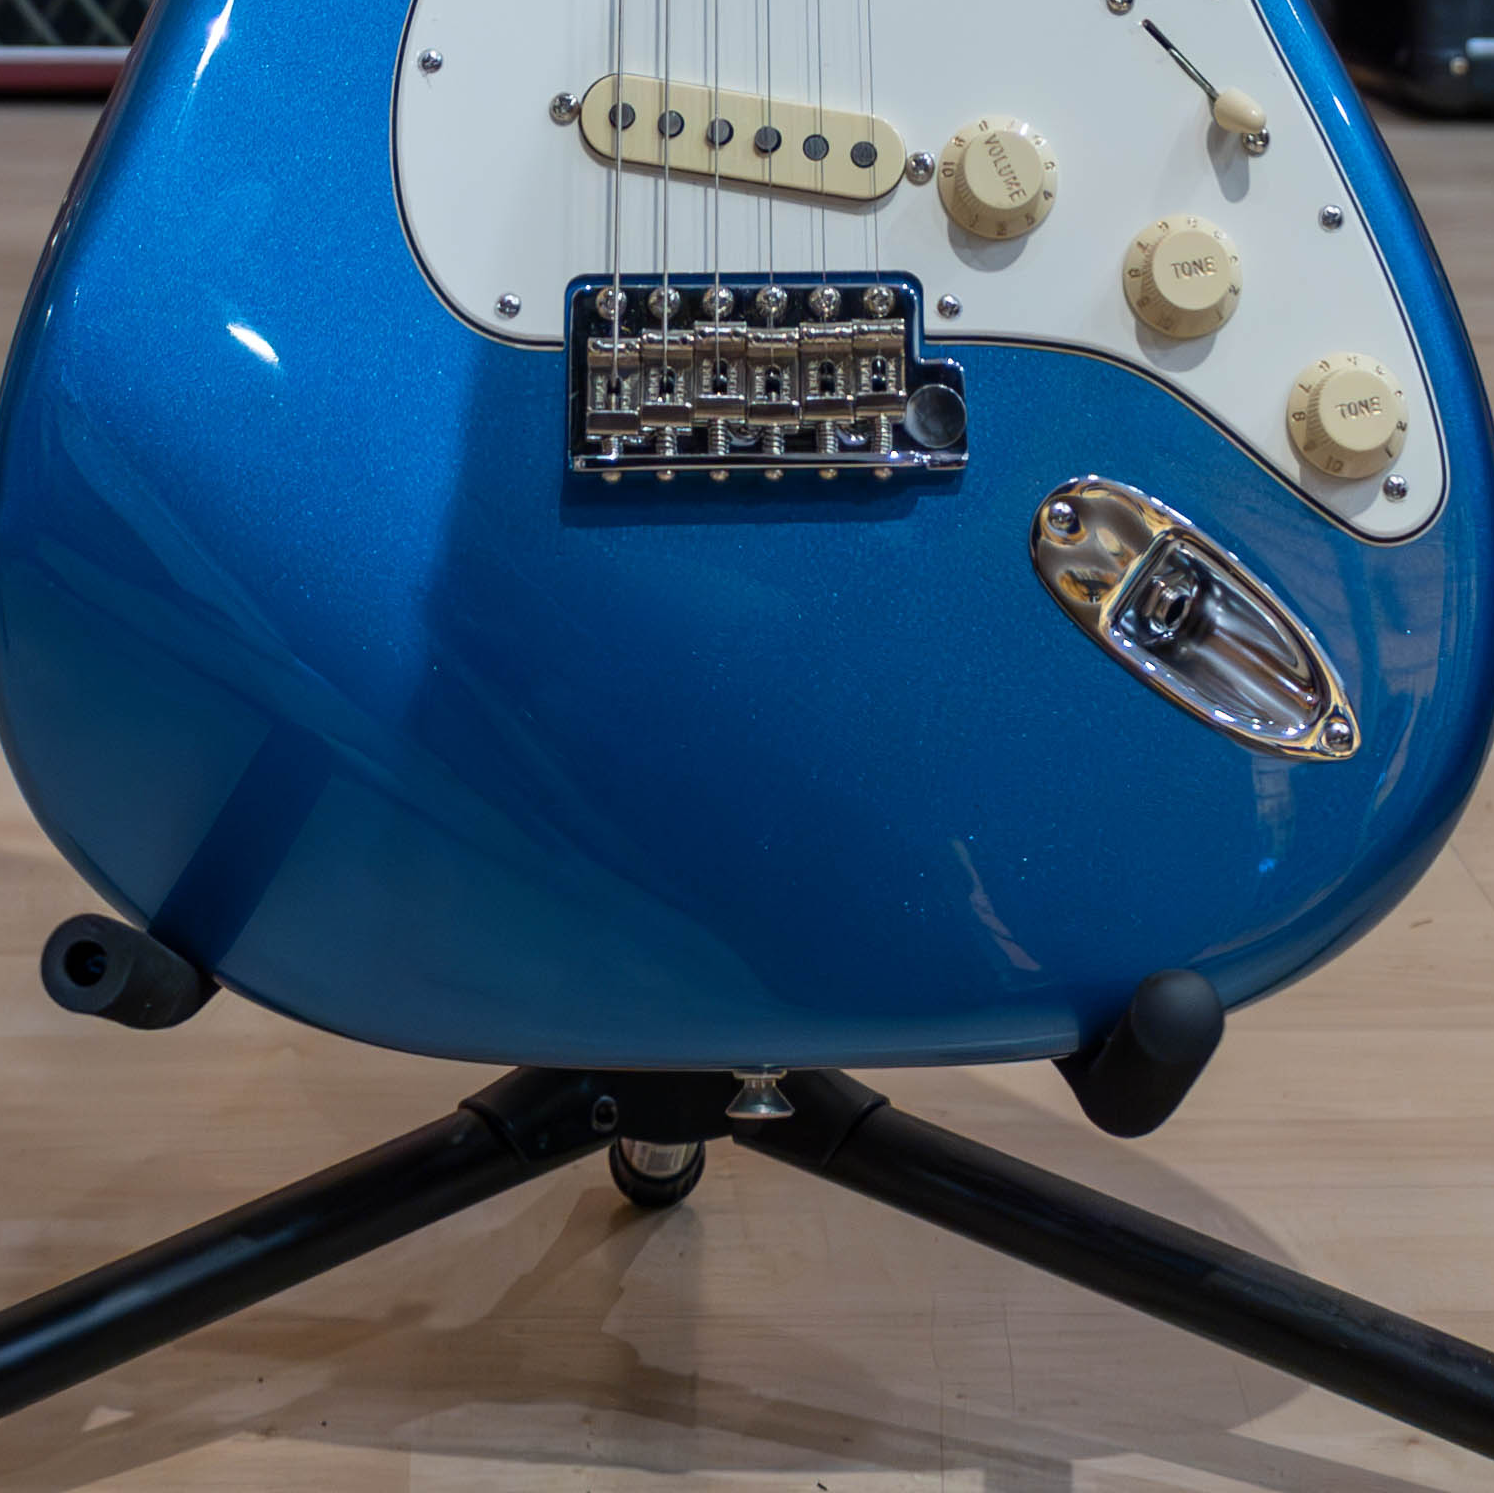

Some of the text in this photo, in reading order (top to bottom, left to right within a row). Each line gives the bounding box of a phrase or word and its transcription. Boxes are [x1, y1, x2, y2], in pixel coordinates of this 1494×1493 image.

[984, 132, 1027, 203] VOLUME
[1171, 256, 1218, 279] TONE
[1334, 396, 1383, 420] TONE
